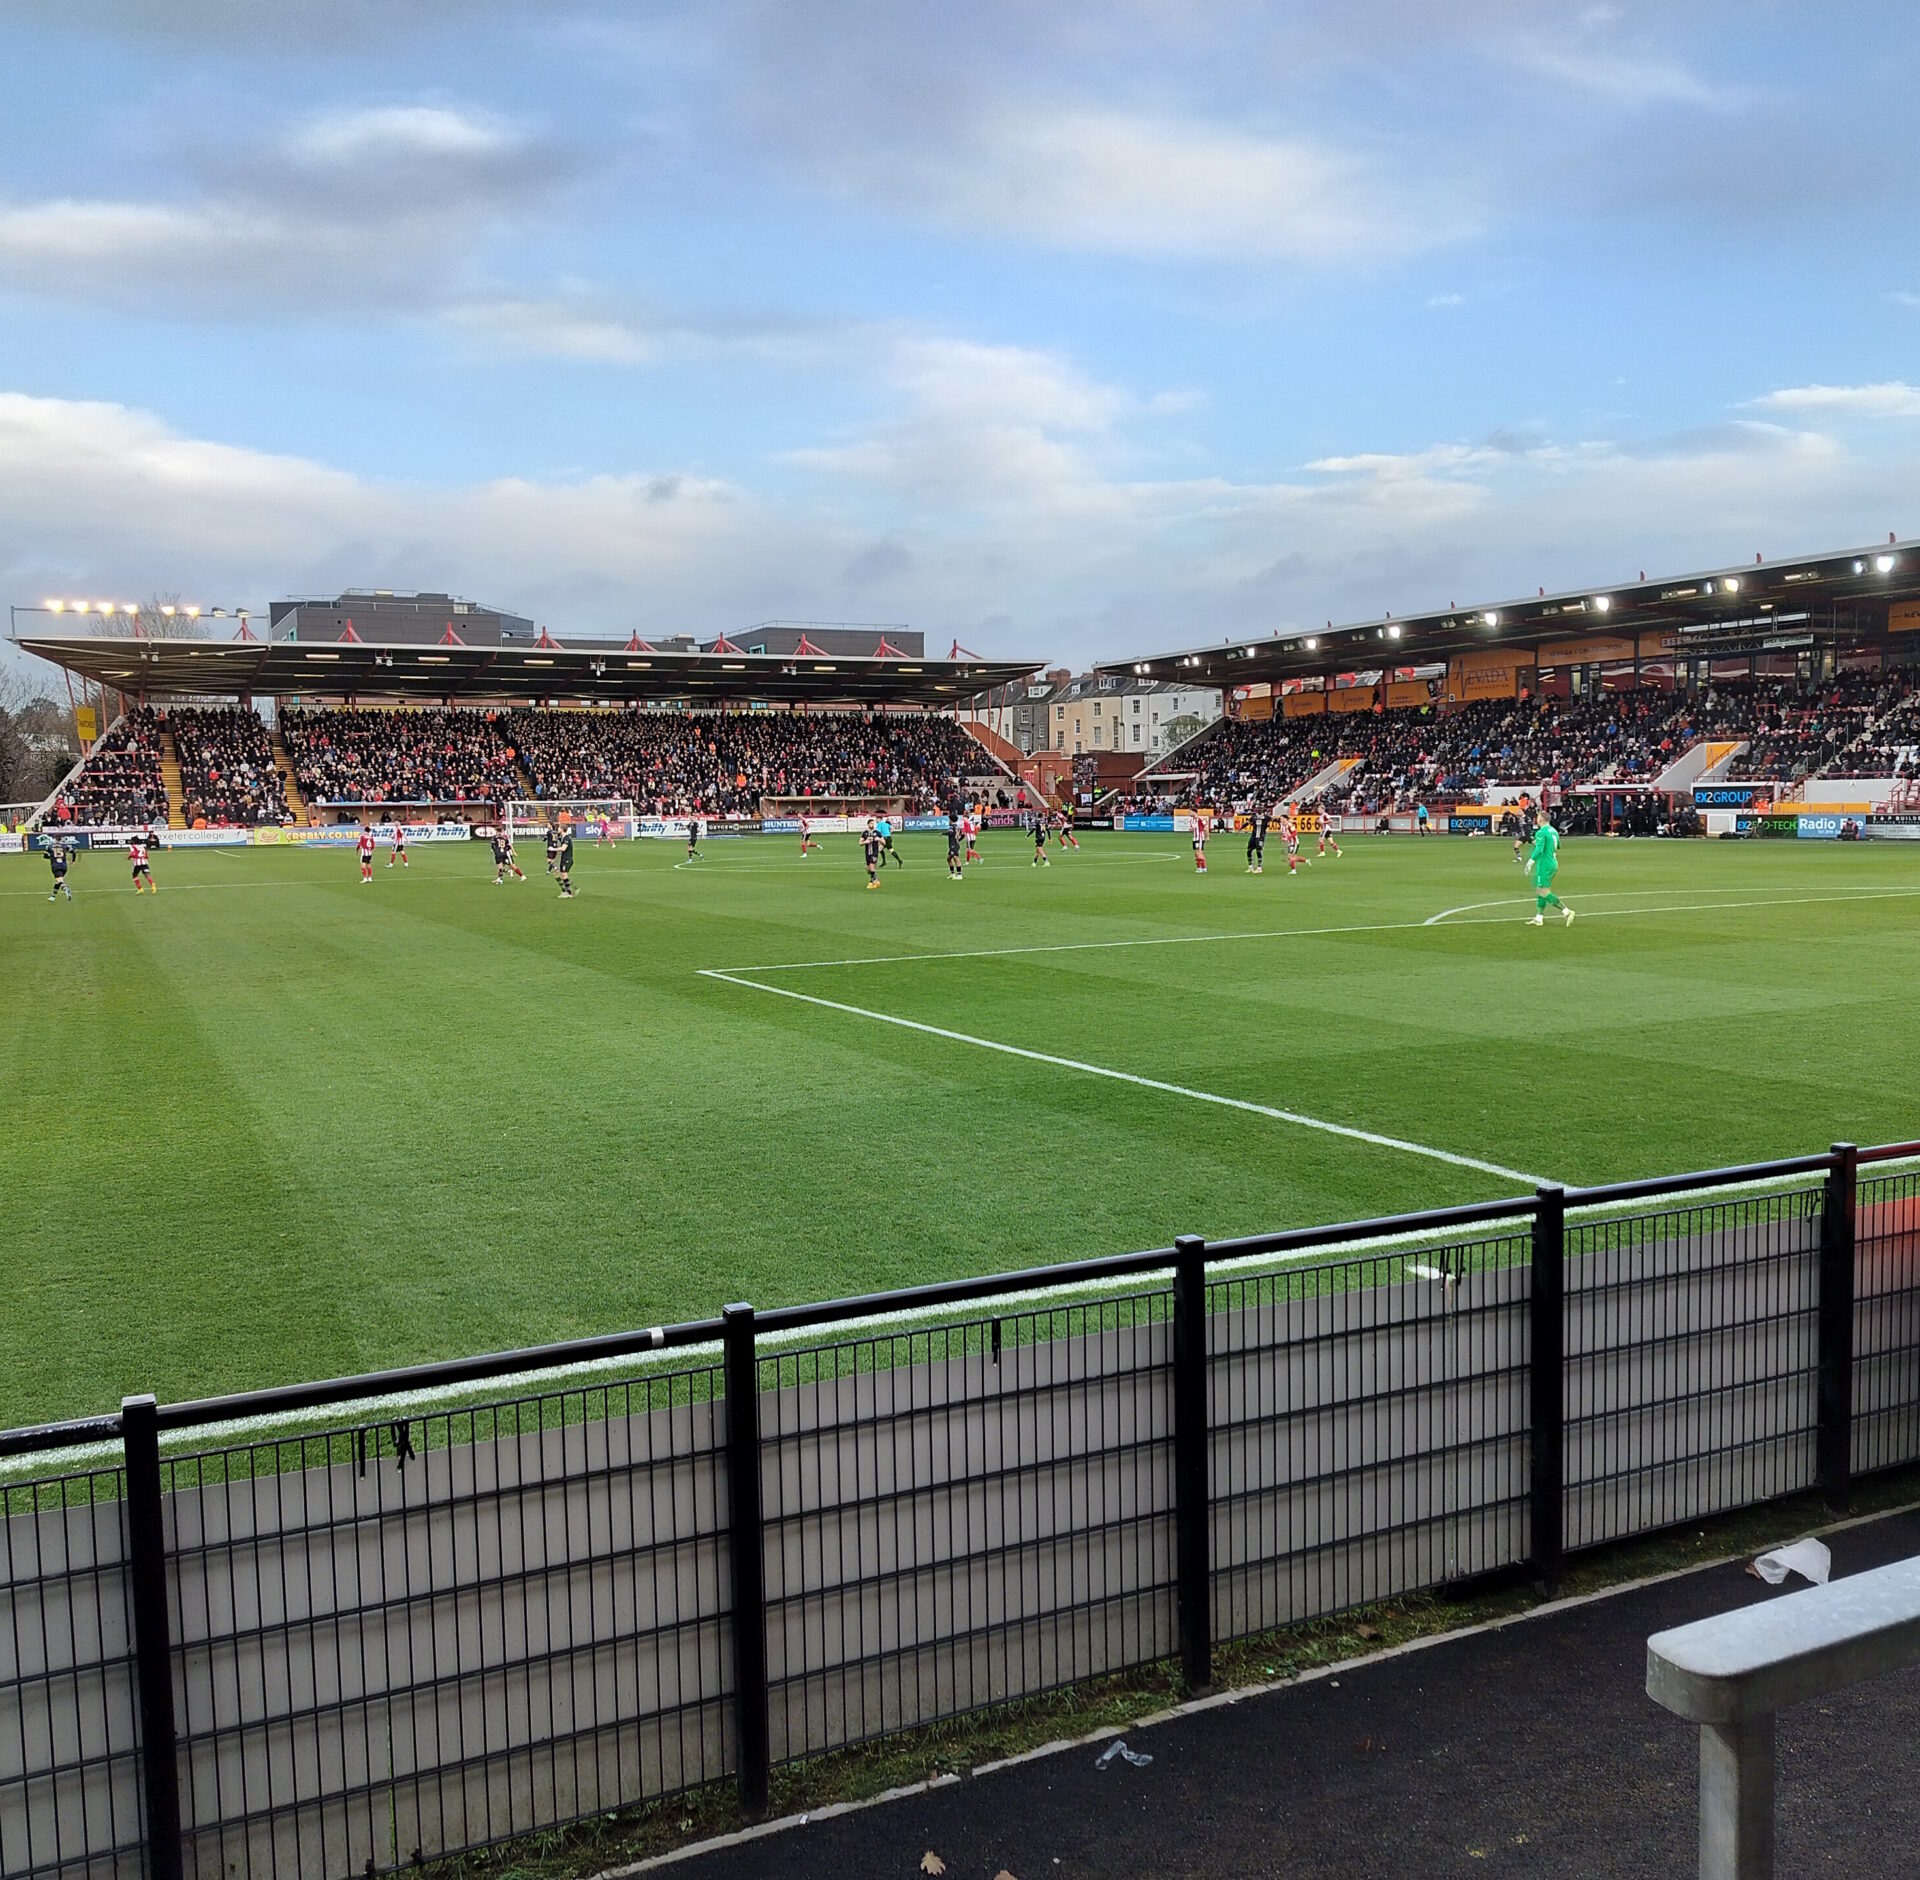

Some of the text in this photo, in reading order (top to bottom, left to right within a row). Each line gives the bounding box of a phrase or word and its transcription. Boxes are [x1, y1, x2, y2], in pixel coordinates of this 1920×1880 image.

[1695, 791, 1753, 803] EX2GROUP
[637, 823, 667, 834] Thrifty
[1451, 818, 1489, 828] EX2GROUP
[1799, 818, 1864, 829] Radio Ee
[402, 828, 433, 839] Thrifty
[436, 826, 468, 838] Thrifty
[585, 824, 602, 836] sky
[157, 831, 187, 841] exeter
[188, 831, 225, 840] college
[497, 839, 506, 848] 18
